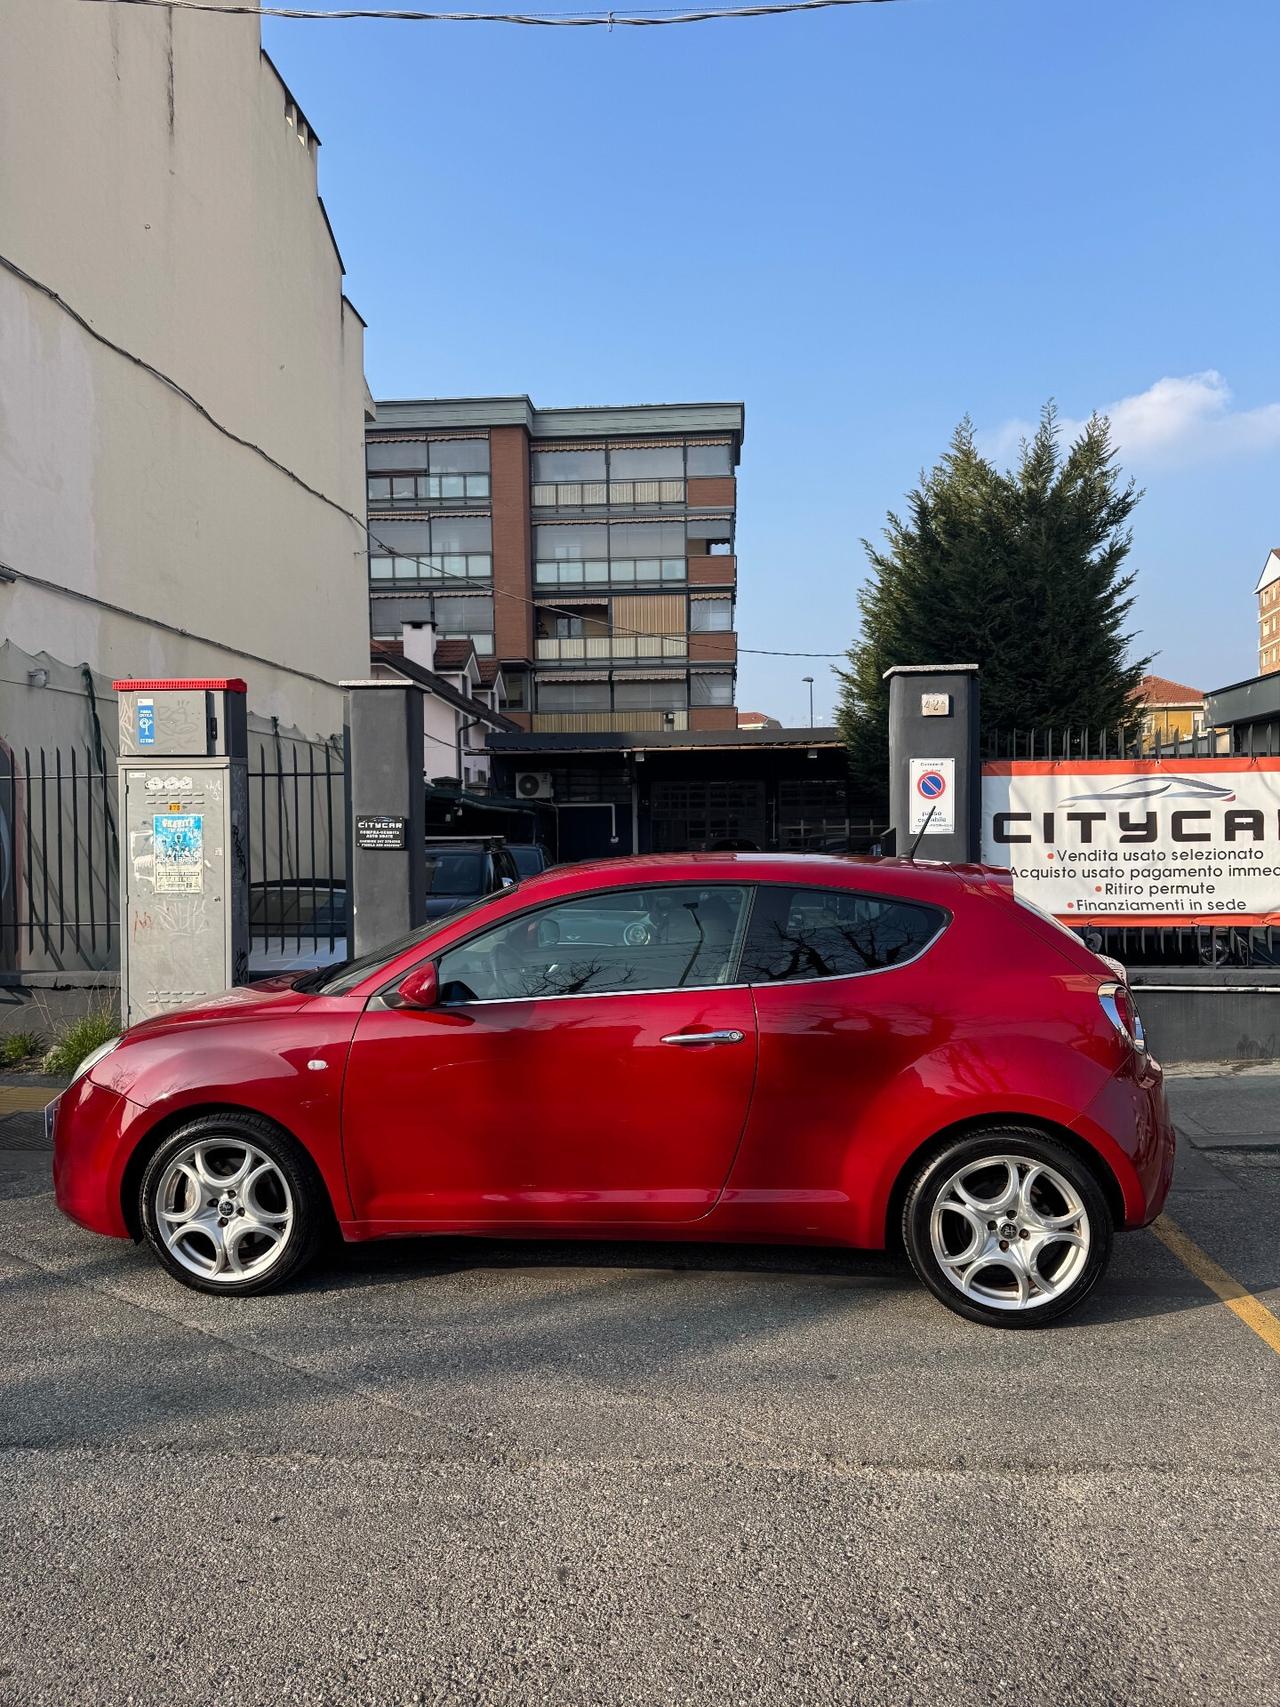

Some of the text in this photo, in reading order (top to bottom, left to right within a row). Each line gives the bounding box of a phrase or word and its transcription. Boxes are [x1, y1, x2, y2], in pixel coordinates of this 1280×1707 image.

[993, 809, 1280, 844] CITYCA
[1056, 848, 1264, 862] Vendita usato selezionato
[1010, 866, 1077, 881] Acquisto
[1082, 866, 1125, 879] usato
[1130, 865, 1223, 881] pagamento
[1105, 882, 1216, 897] Ritiro permute
[1076, 898, 1247, 911] Finanziamenti in sede
